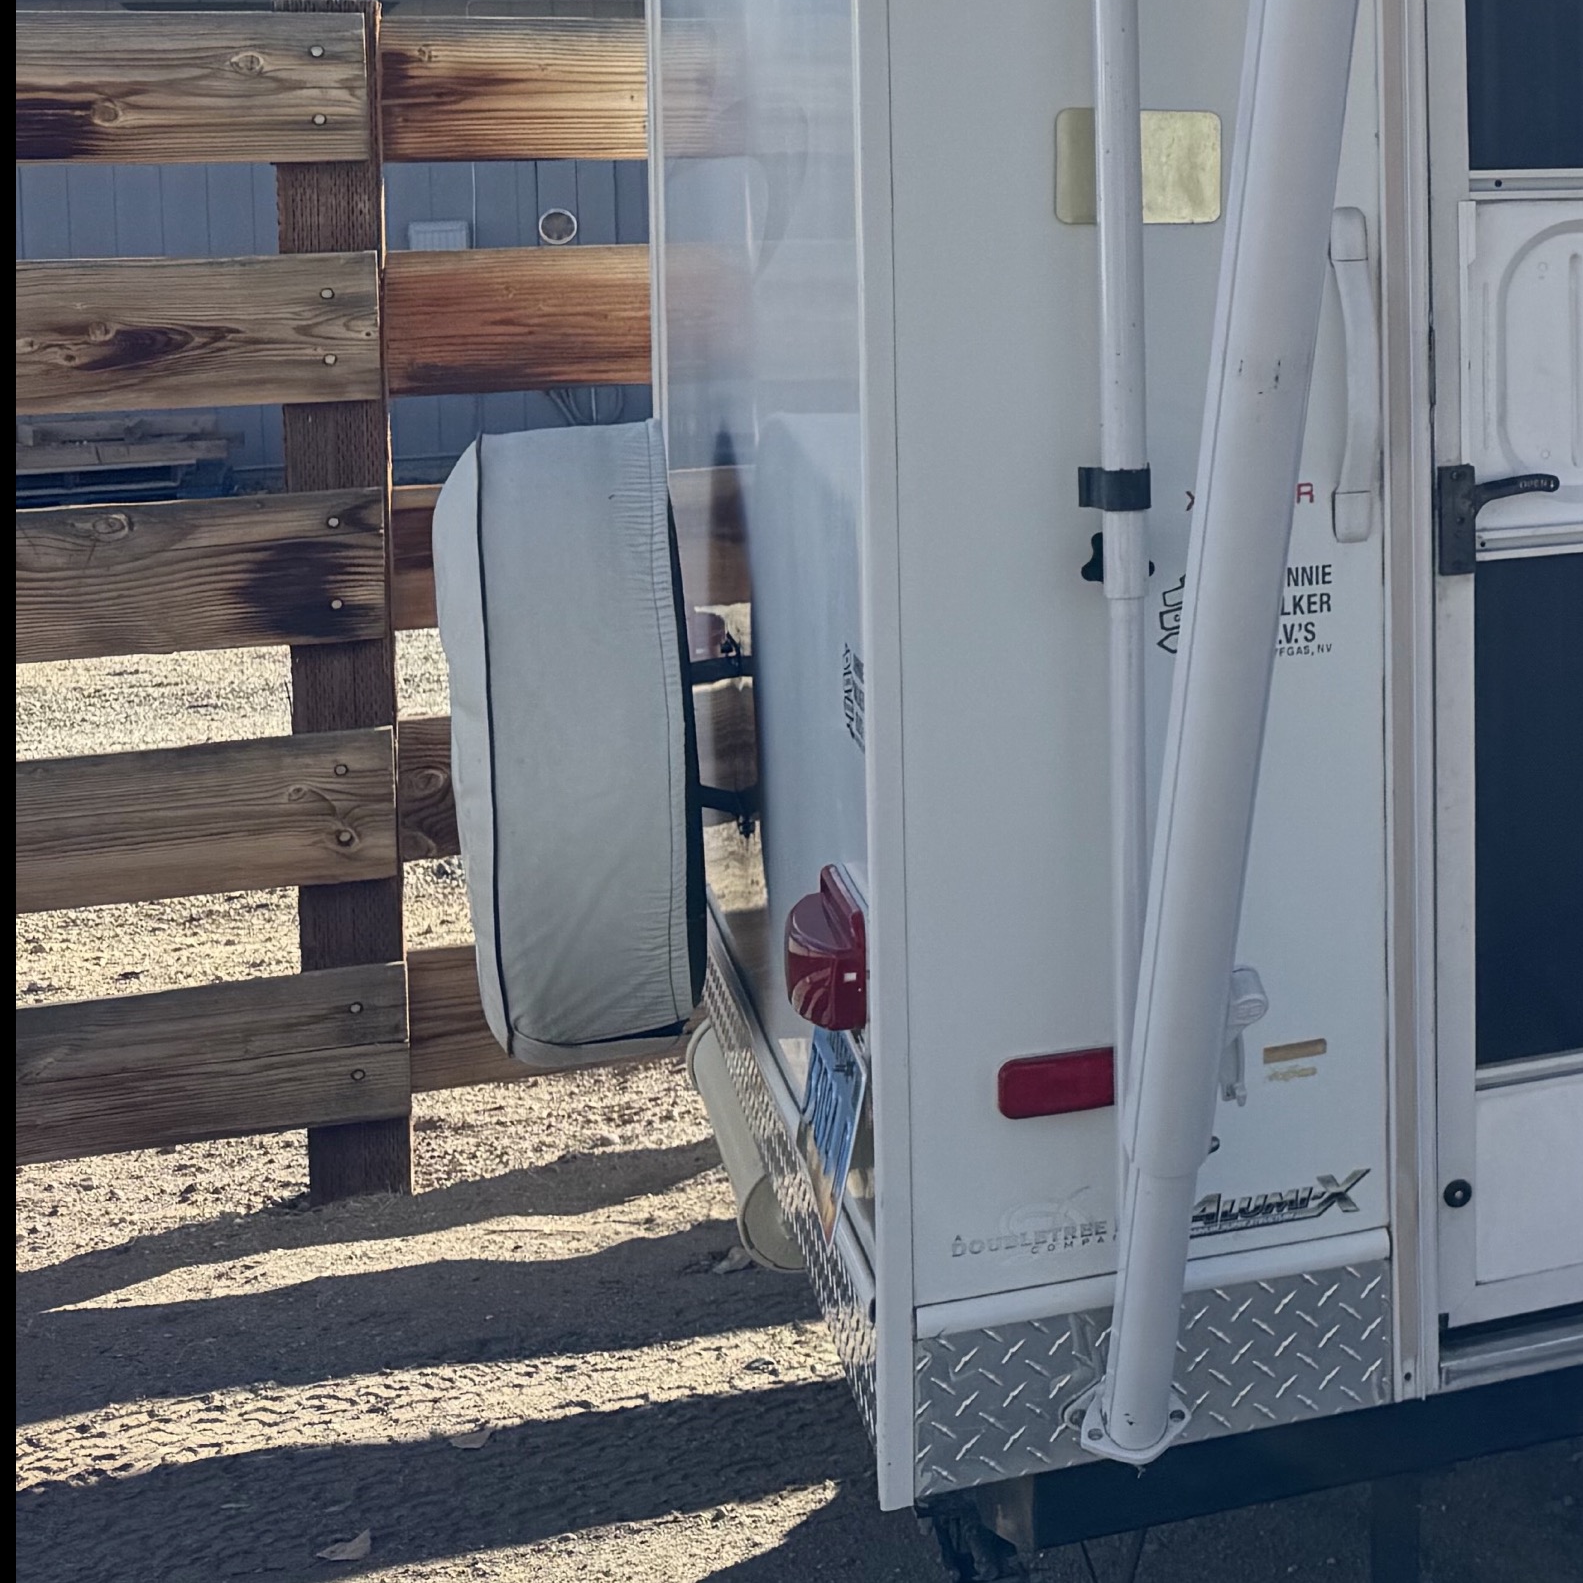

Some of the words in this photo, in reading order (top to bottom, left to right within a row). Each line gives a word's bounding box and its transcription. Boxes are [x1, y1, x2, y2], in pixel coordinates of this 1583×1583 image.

[1286, 564, 1332, 587] NNIE
[1280, 593, 1331, 616] LKER
[1278, 621, 1316, 644] .V.'S
[1317, 643, 1332, 653] NV
[1030, 1233, 1117, 1255] COMPA
